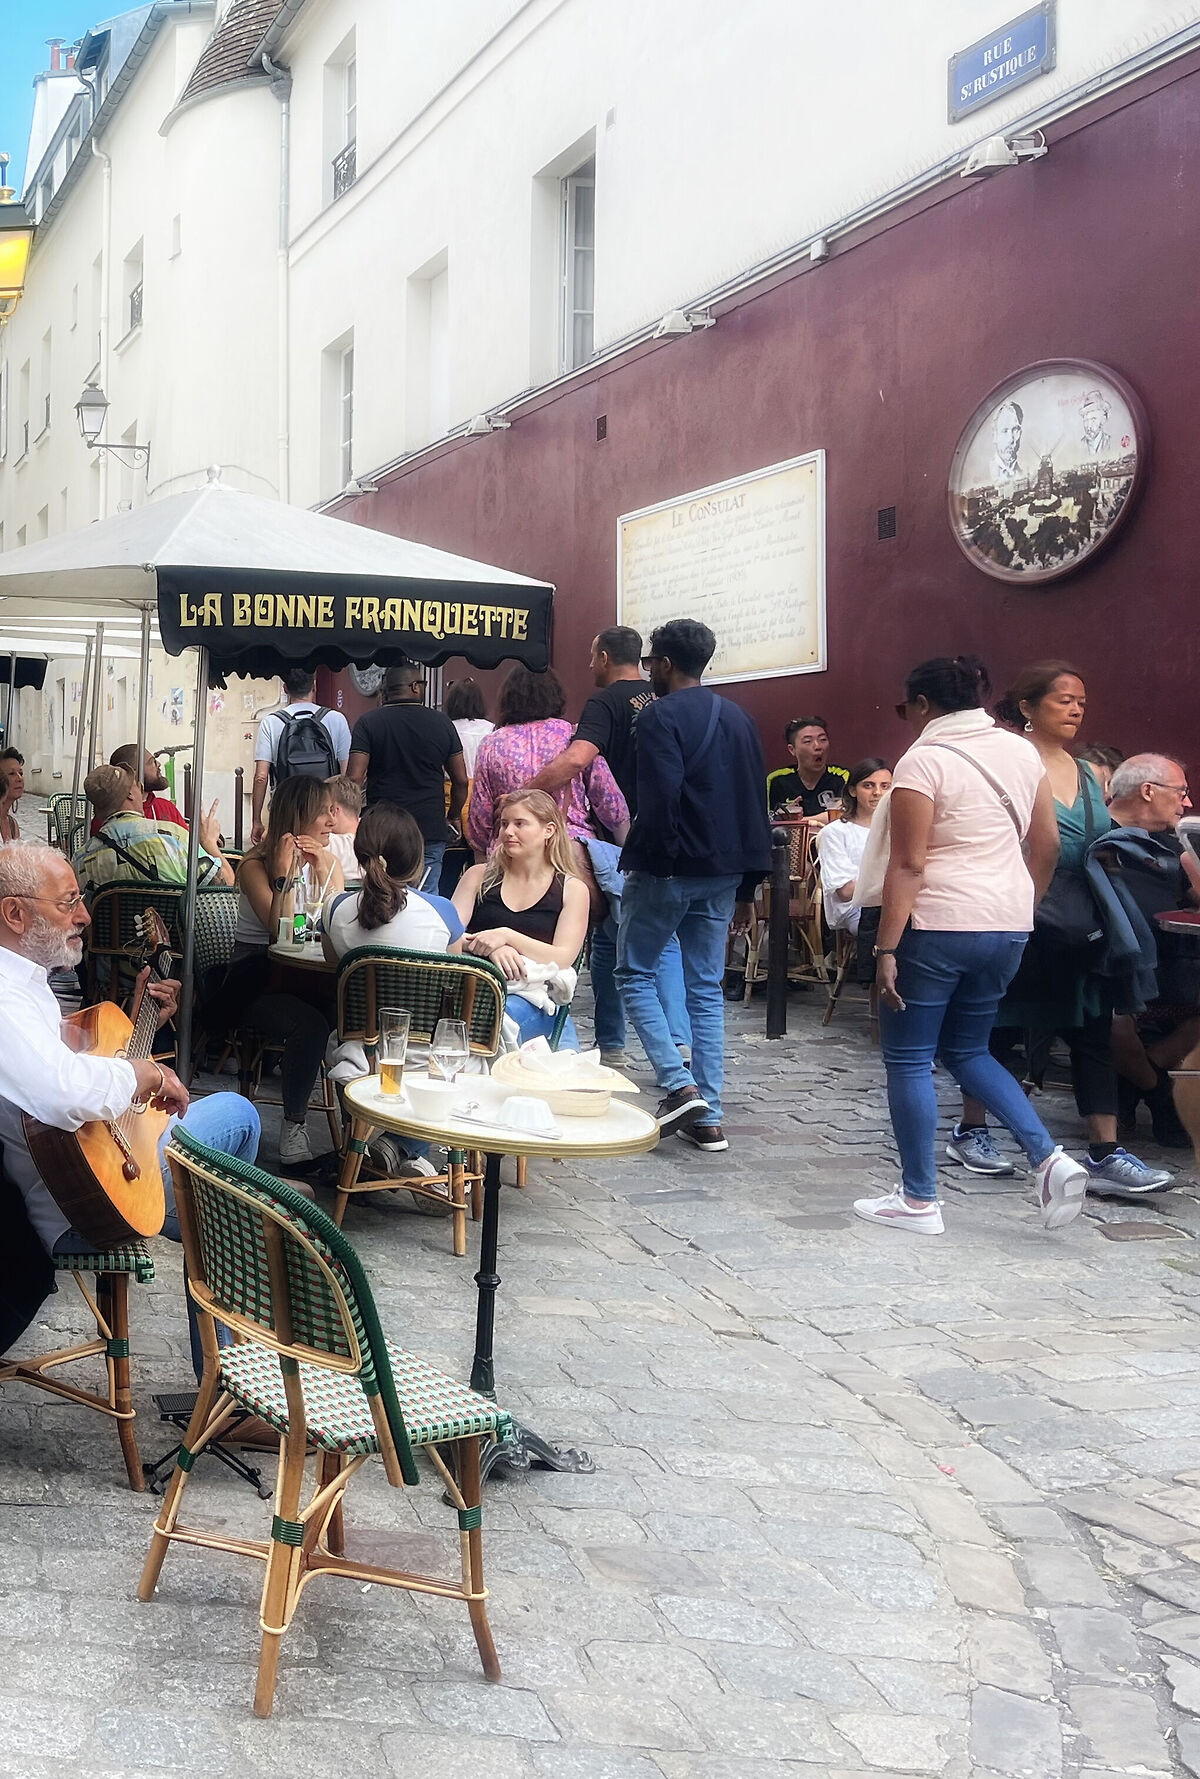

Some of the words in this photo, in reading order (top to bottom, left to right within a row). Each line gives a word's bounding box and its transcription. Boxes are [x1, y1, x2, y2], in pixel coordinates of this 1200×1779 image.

[973, 45, 1036, 95] RUSTIQUE
[983, 37, 1012, 67] RUE
[672, 510, 682, 528] LE
[689, 492, 746, 522] CONSULAT
[179, 592, 223, 627] LA
[232, 592, 335, 628] BONNE
[344, 596, 530, 641] FRANQUETTE
